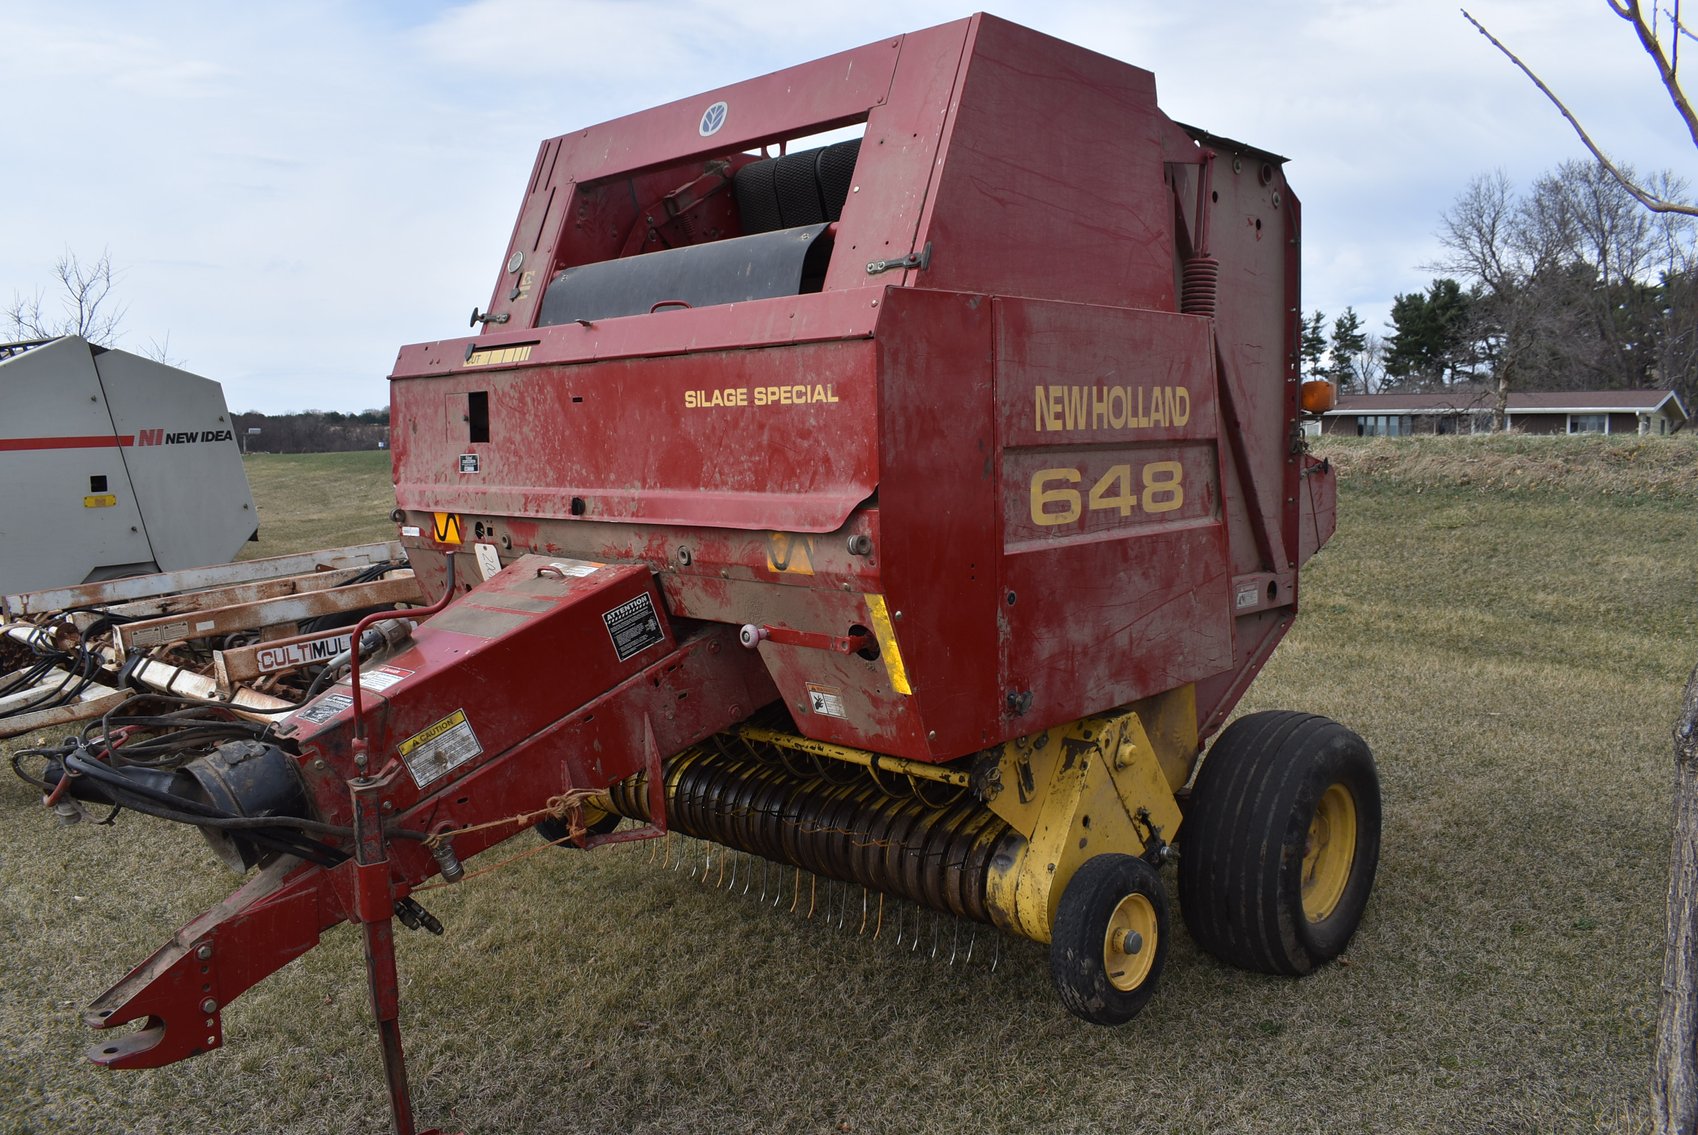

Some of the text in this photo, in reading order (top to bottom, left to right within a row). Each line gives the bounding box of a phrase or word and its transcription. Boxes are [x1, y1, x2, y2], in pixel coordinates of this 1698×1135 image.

[684, 384, 839, 408] SILAGE SPECIAL
[1035, 385, 1190, 431] NEW HOLLAND
[138, 428, 233, 446] NI NEW IDEA
[1030, 460, 1184, 526] 648
[606, 595, 648, 621] ATTENTION
[261, 633, 364, 669] CULTIMUL
[420, 718, 454, 741] CAUTION
